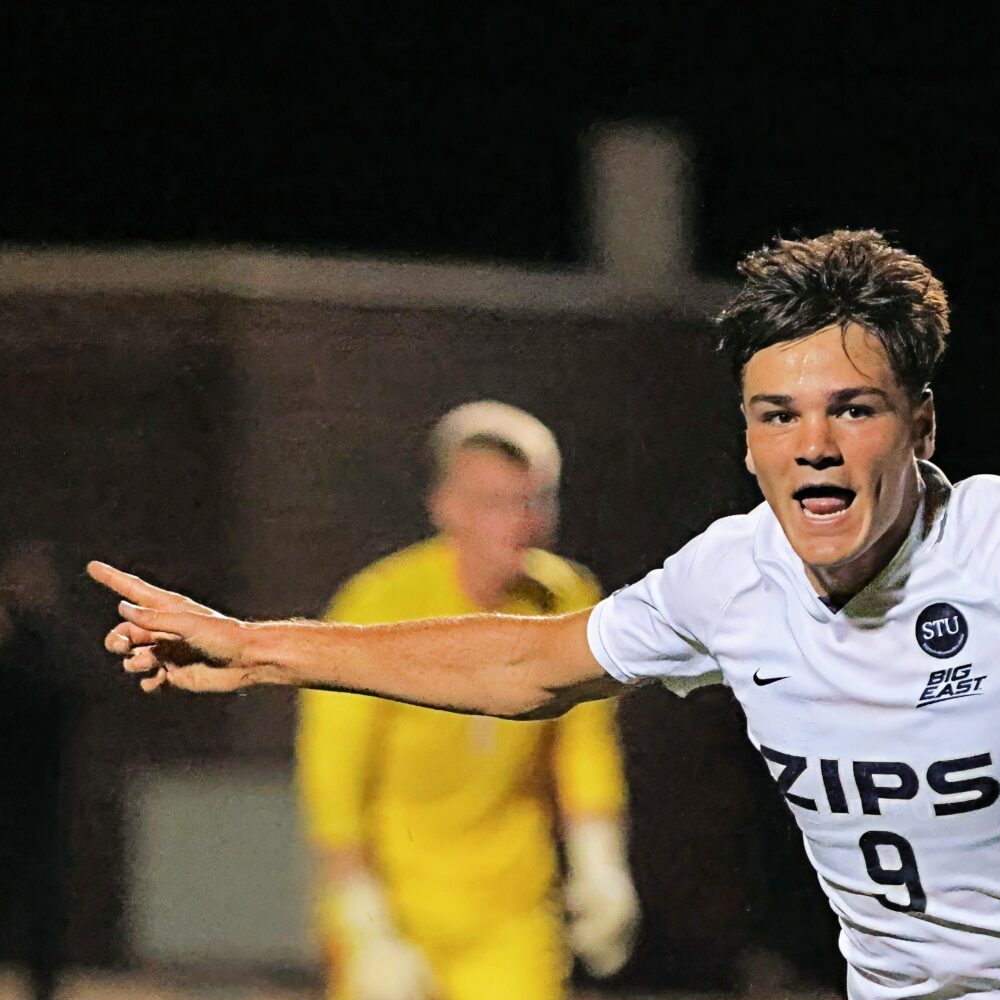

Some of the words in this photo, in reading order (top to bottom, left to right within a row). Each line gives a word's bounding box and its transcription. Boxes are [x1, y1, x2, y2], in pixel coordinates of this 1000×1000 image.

[921, 616, 959, 640] STU
[927, 663, 972, 686] BIG
[919, 676, 988, 701] EAST
[760, 744, 1000, 816] ZIPS
[859, 830, 927, 913] 9
